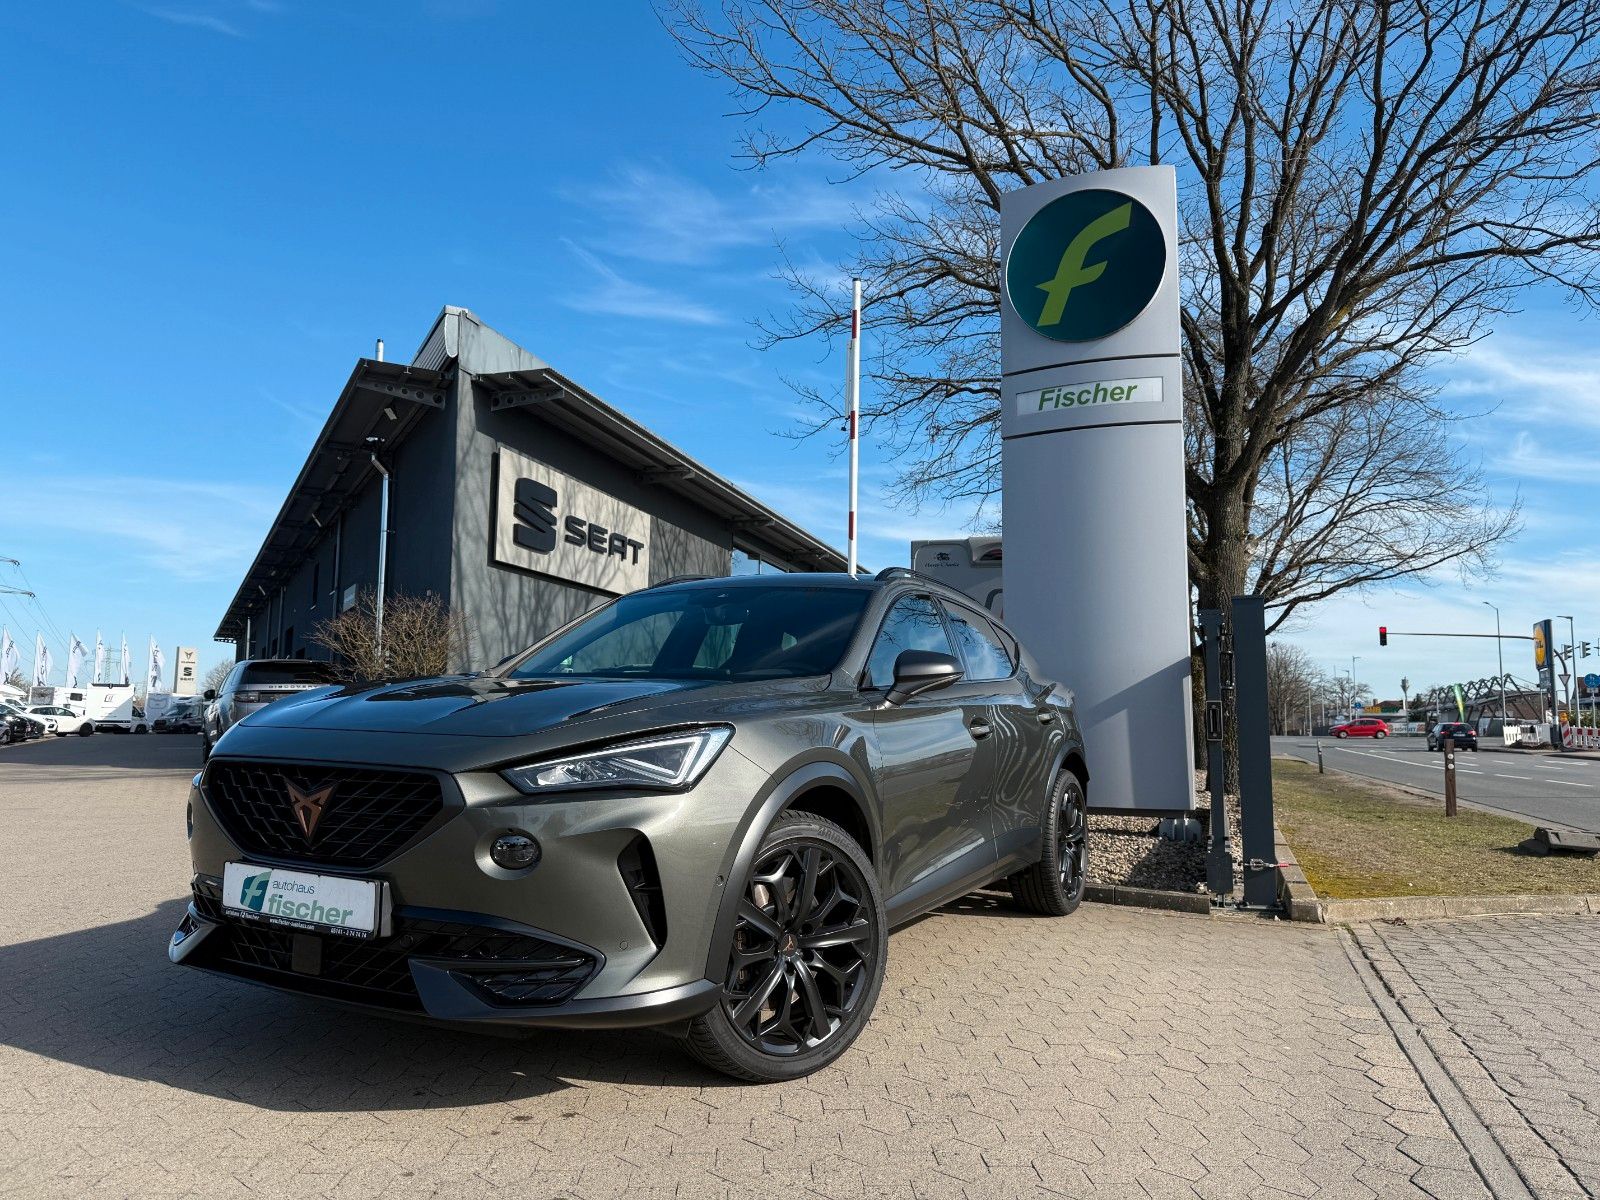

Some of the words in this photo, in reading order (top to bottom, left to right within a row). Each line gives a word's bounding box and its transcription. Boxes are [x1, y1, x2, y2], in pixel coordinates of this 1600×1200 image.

[1038, 382, 1137, 411] Fischer
[564, 514, 645, 566] SEAT
[272, 879, 315, 894] autohaus
[268, 894, 354, 925] fischer
